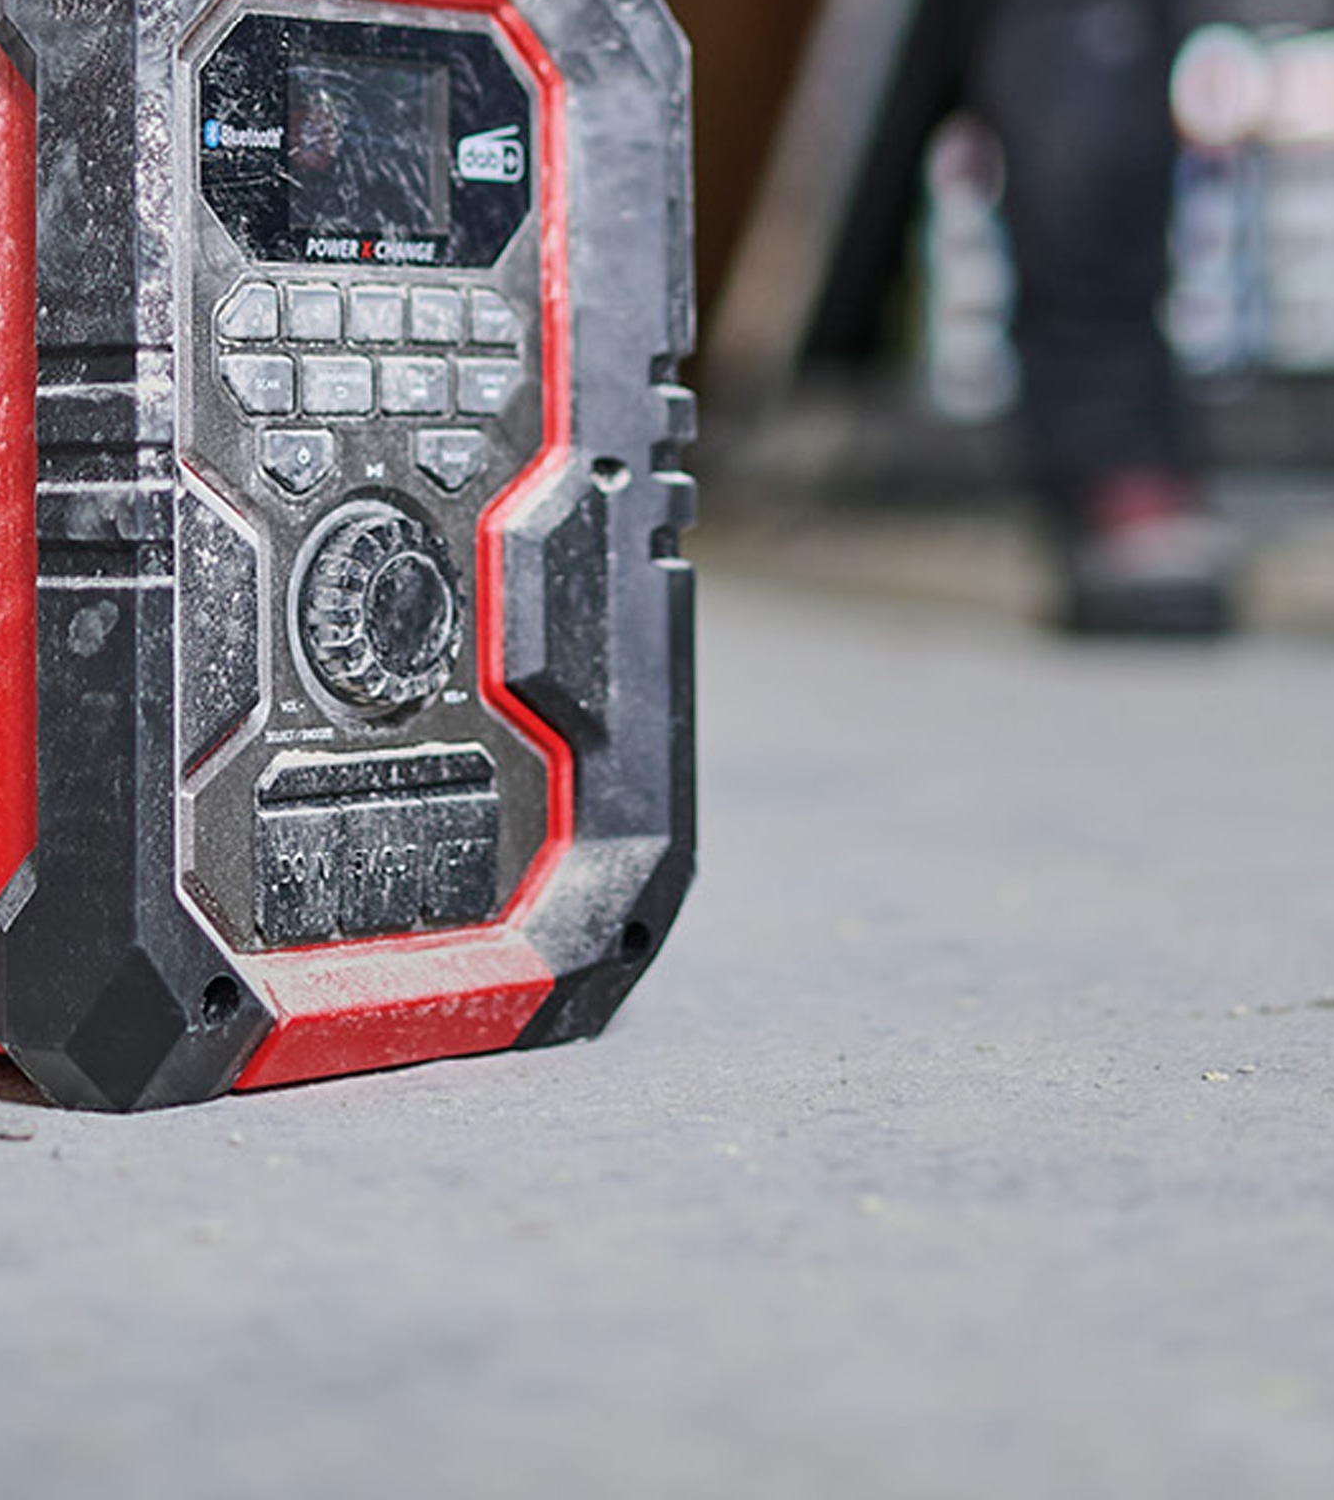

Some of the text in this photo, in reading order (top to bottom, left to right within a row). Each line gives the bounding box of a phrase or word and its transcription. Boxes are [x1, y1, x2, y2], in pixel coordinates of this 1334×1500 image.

[220, 124, 285, 149] Bluetooth
[305, 237, 437, 262] POWER X-CHANGE
